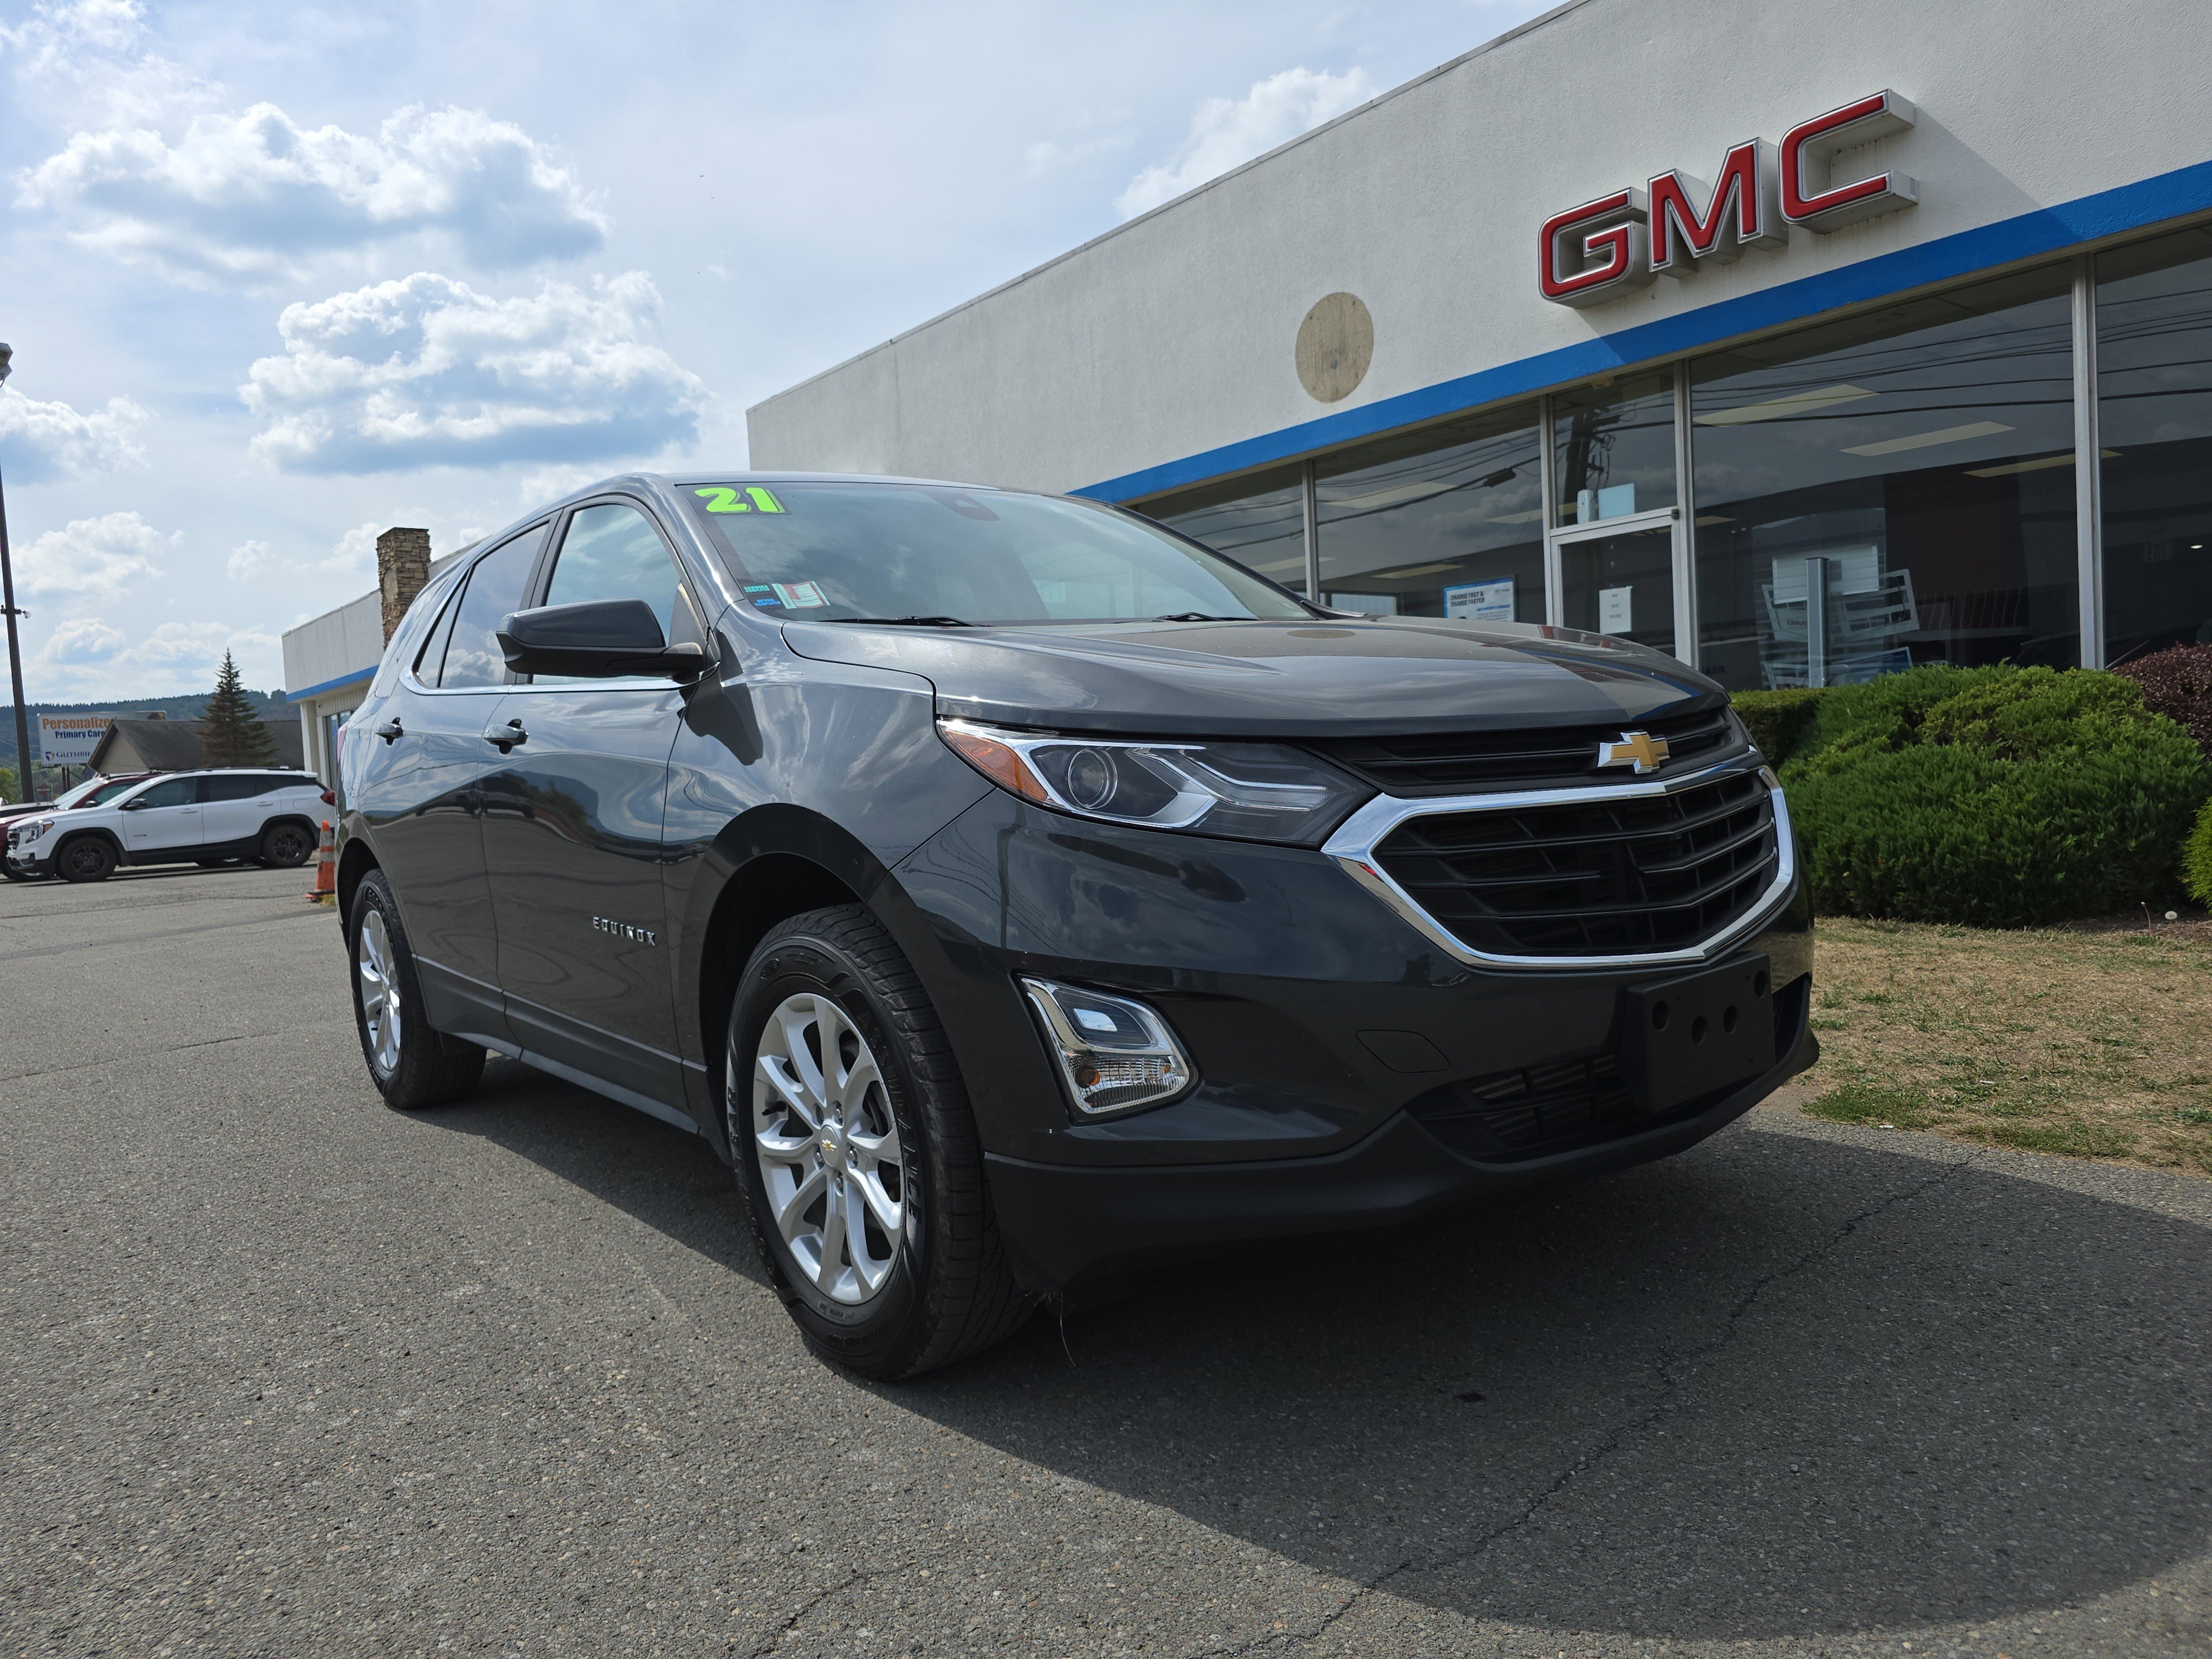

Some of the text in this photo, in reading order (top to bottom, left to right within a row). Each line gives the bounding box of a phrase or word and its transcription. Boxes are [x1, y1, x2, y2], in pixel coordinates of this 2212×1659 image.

[1539, 88, 1918, 308] GMC
[695, 487, 786, 514] 21
[43, 717, 117, 730] Personalize
[55, 730, 86, 739] Primary
[593, 916, 656, 946] EQUINOX
